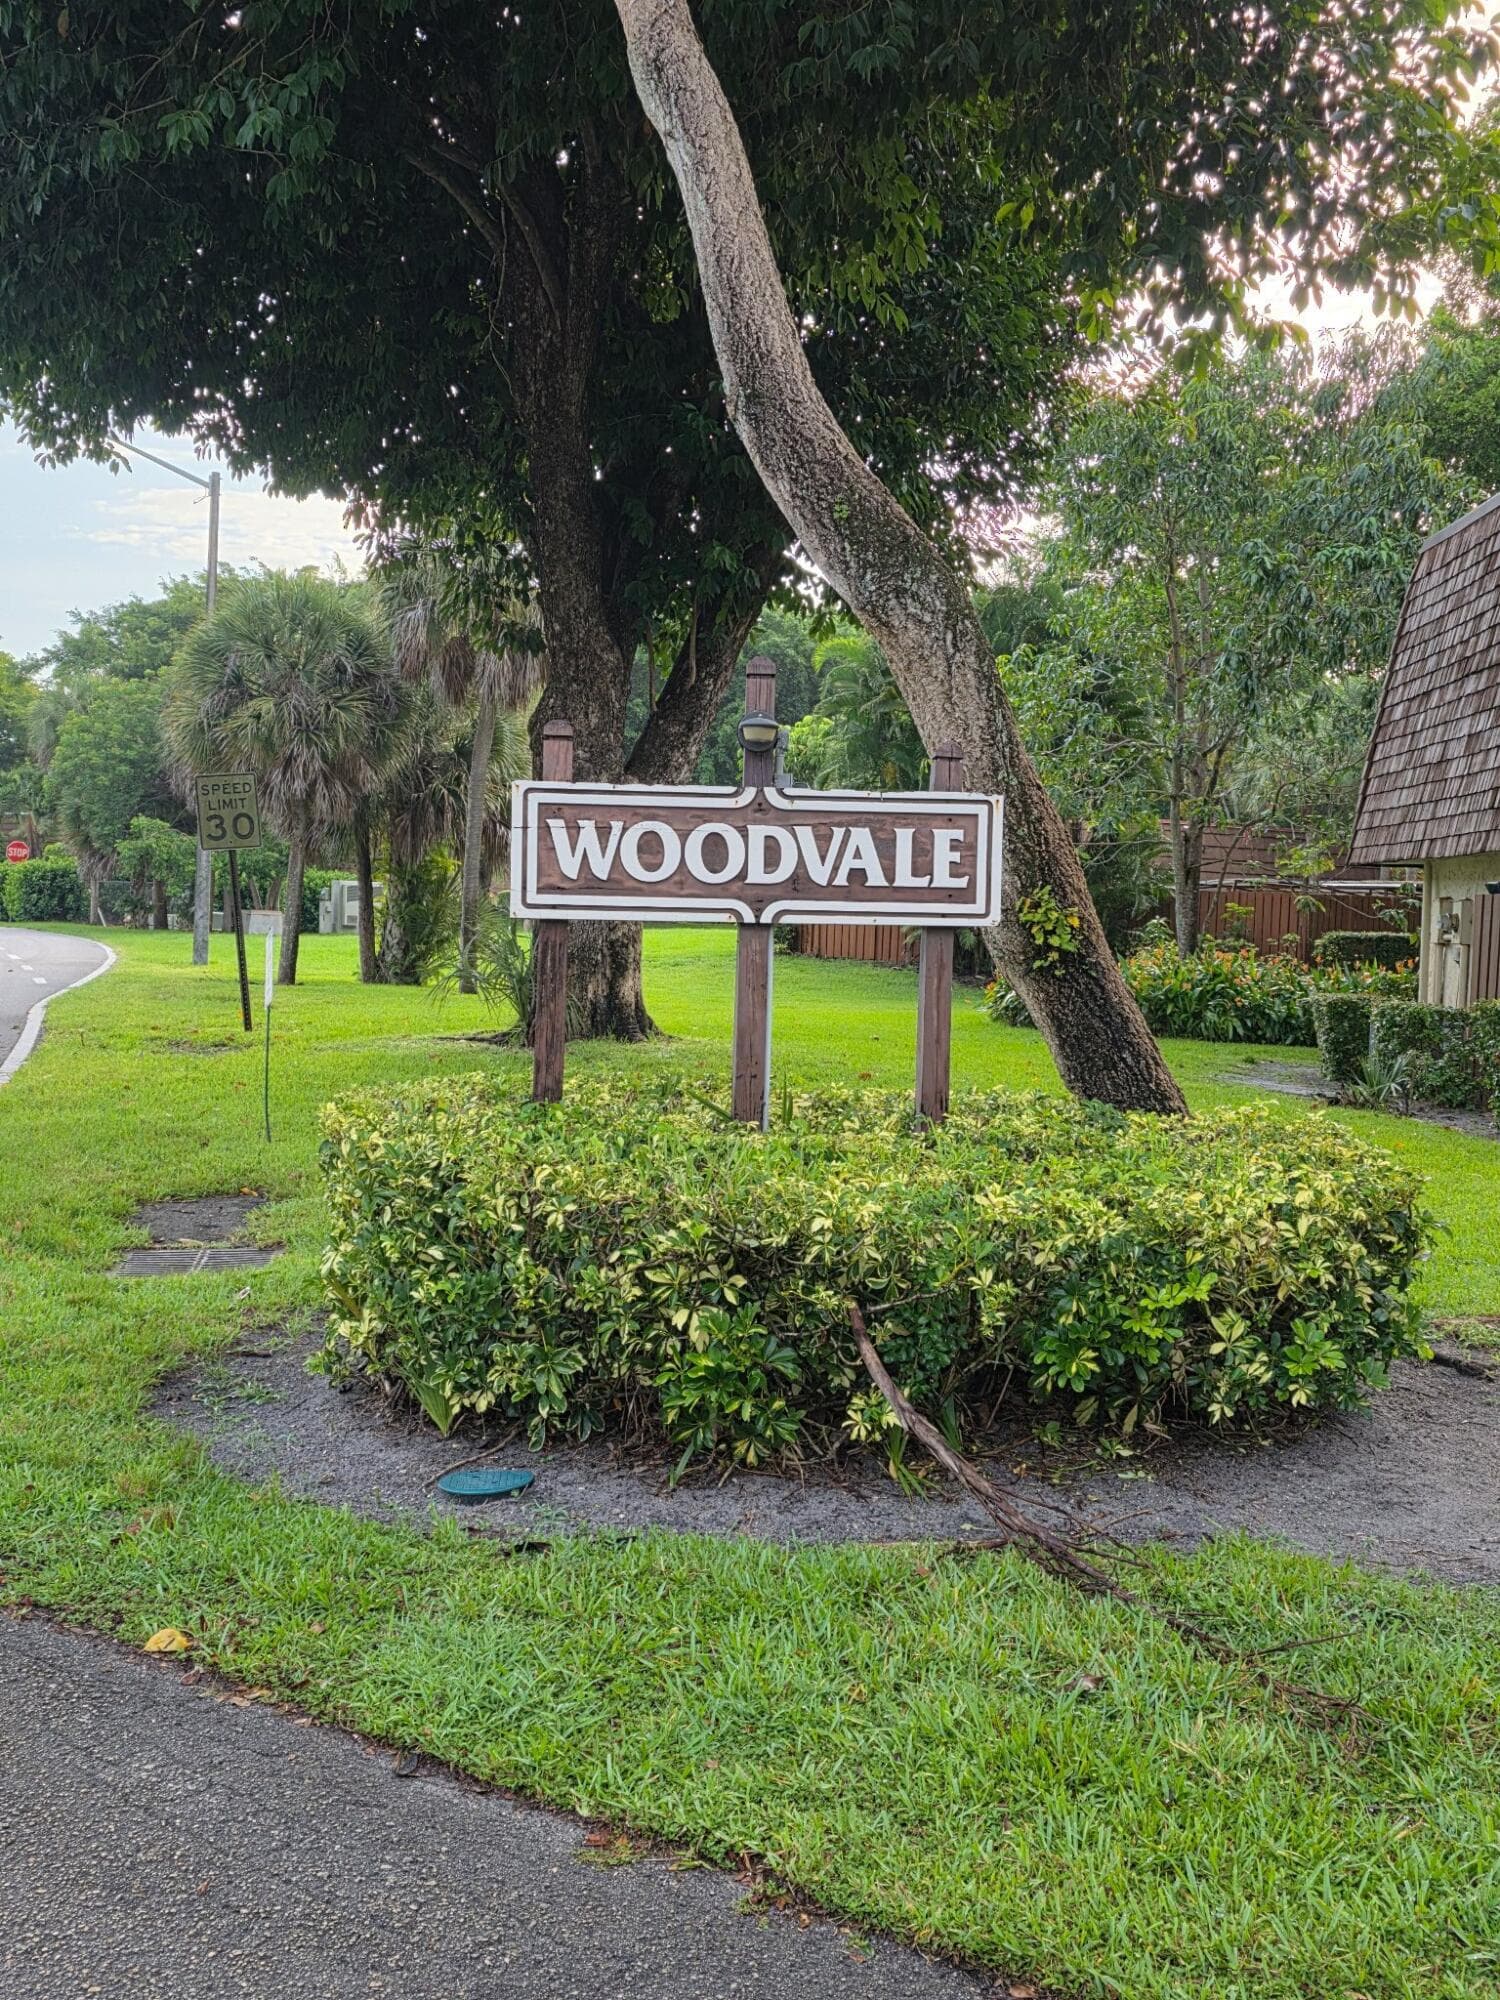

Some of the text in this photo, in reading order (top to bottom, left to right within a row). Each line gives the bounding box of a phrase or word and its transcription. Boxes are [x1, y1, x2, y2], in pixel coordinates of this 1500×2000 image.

[201, 782, 252, 796] SPEED
[208, 798, 247, 811] LIMIT
[206, 812, 255, 841] 30
[8, 847, 28, 857] STOP
[545, 818, 970, 889] WOODVALE
